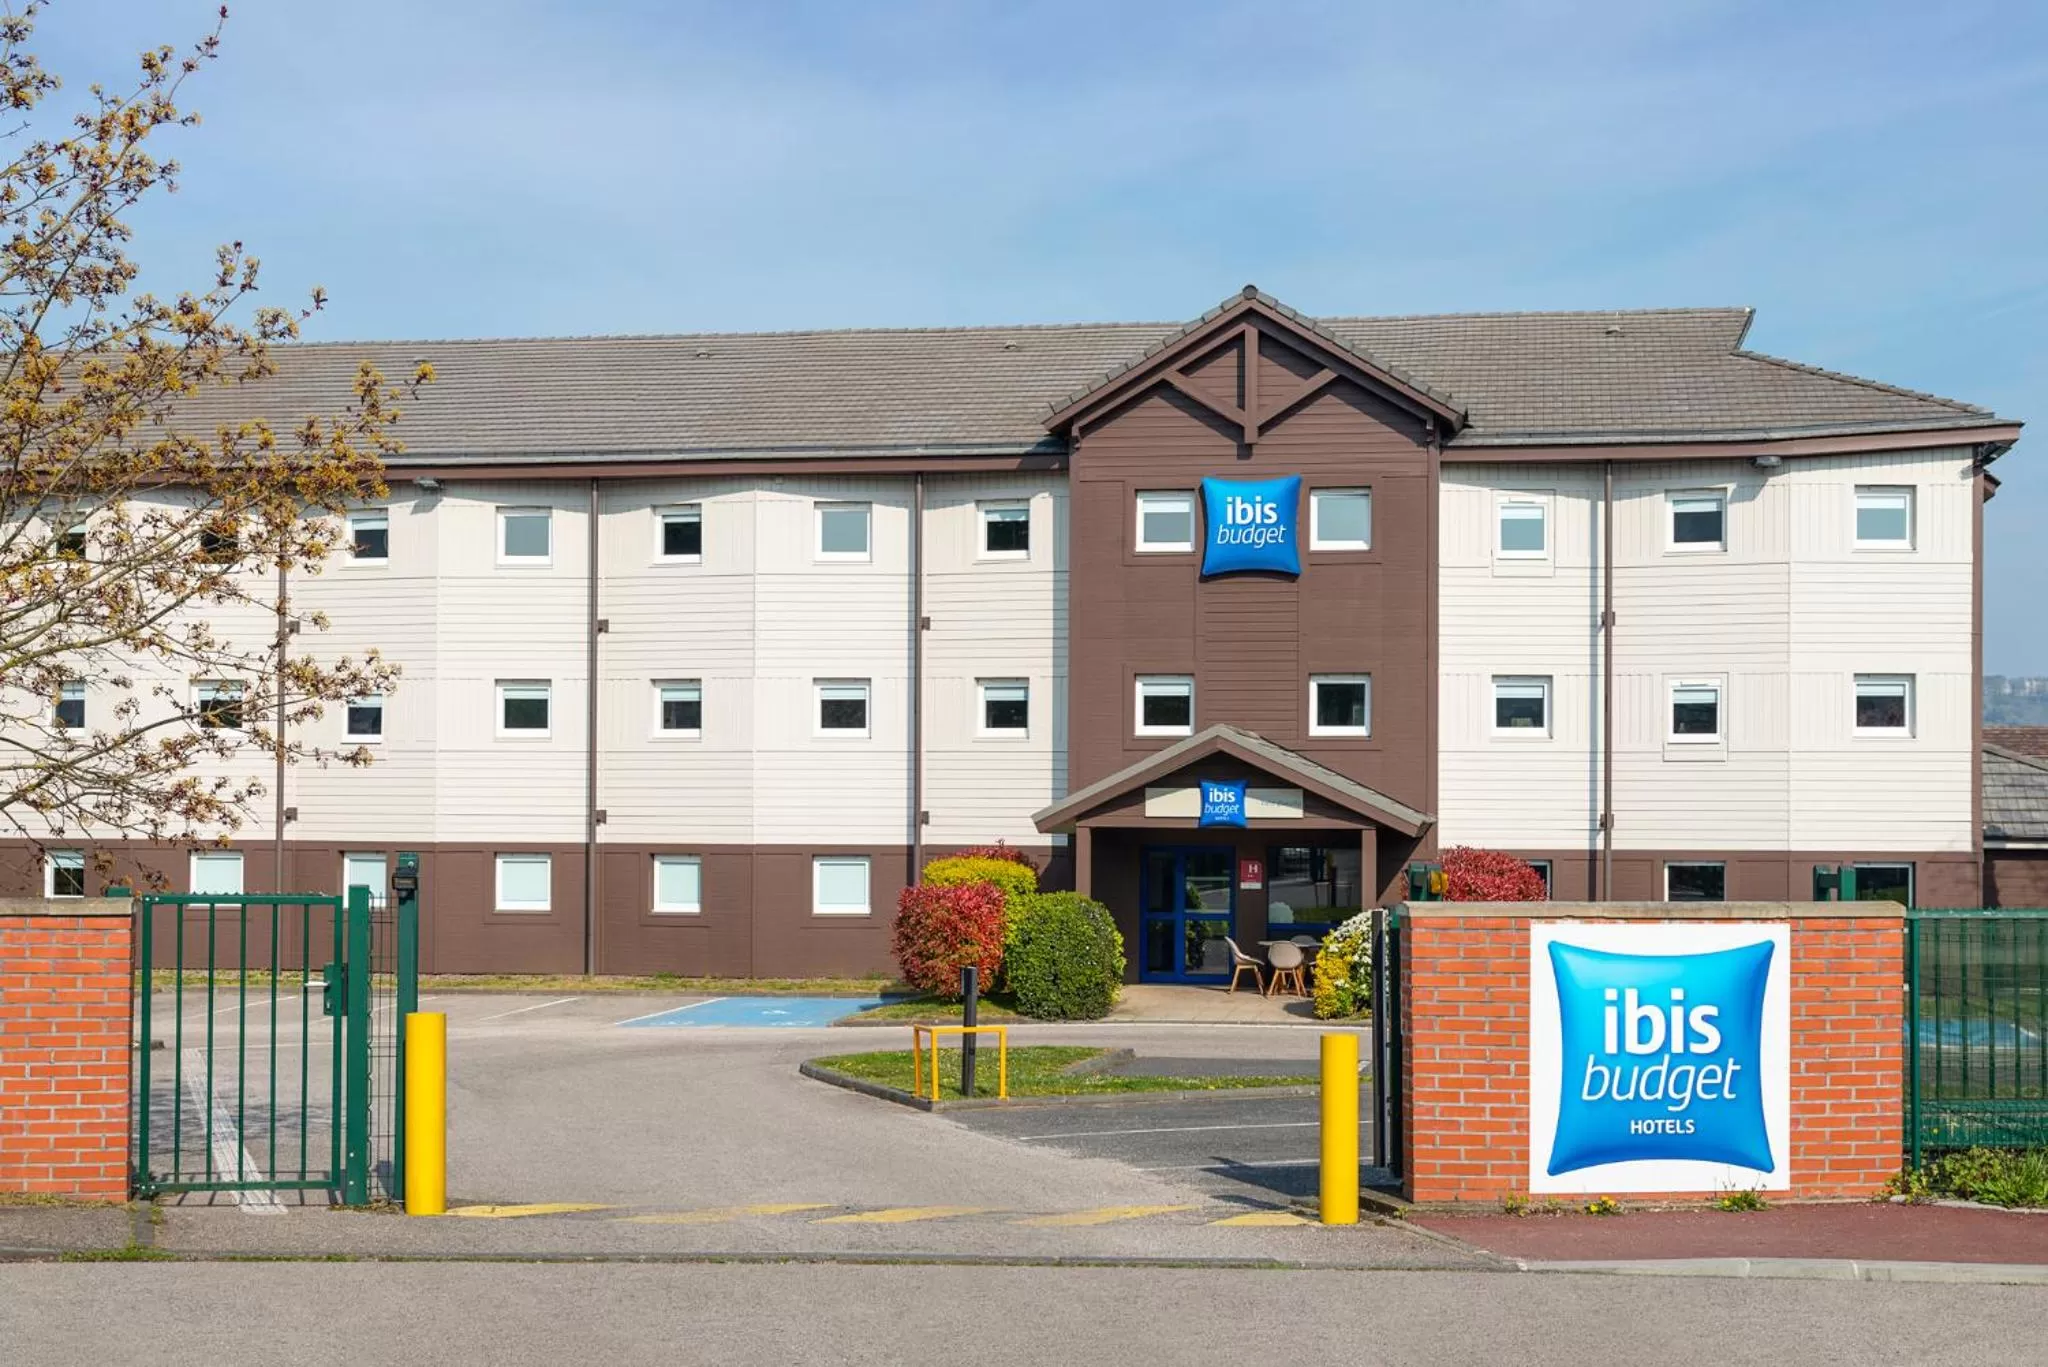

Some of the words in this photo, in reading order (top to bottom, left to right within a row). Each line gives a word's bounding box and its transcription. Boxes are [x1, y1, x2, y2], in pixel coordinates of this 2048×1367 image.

[1227, 496, 1278, 525] ibis
[1217, 524, 1287, 548] budget
[1209, 788, 1236, 803] ibis
[1204, 803, 1240, 815] budget
[1248, 863, 1258, 873] H
[1604, 988, 1722, 1055] ibis
[1581, 1054, 1741, 1112] budget
[1630, 1119, 1695, 1135] HOTELS
